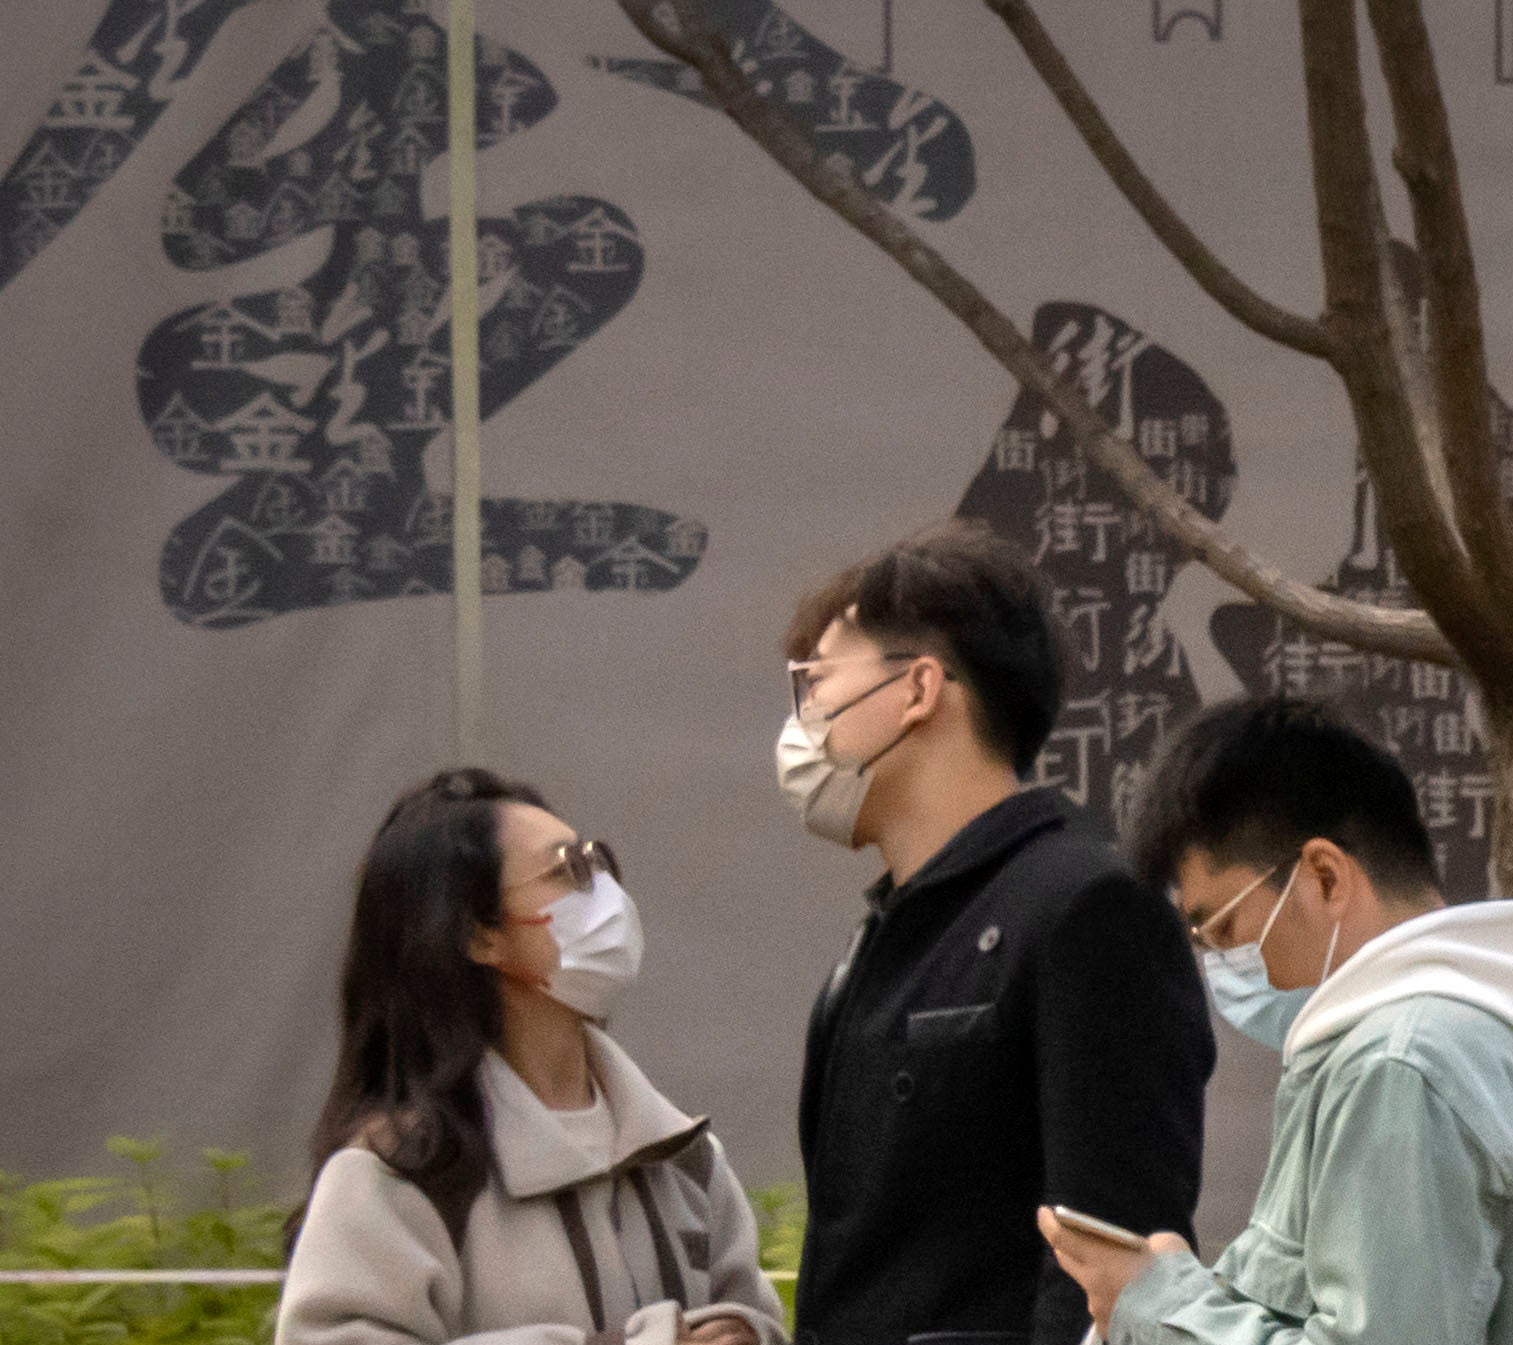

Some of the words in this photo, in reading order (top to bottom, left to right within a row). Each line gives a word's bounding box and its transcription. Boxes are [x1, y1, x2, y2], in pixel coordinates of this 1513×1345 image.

[566, 208, 637, 273] 金
[175, 302, 284, 371] 金
[219, 390, 315, 471] 金
